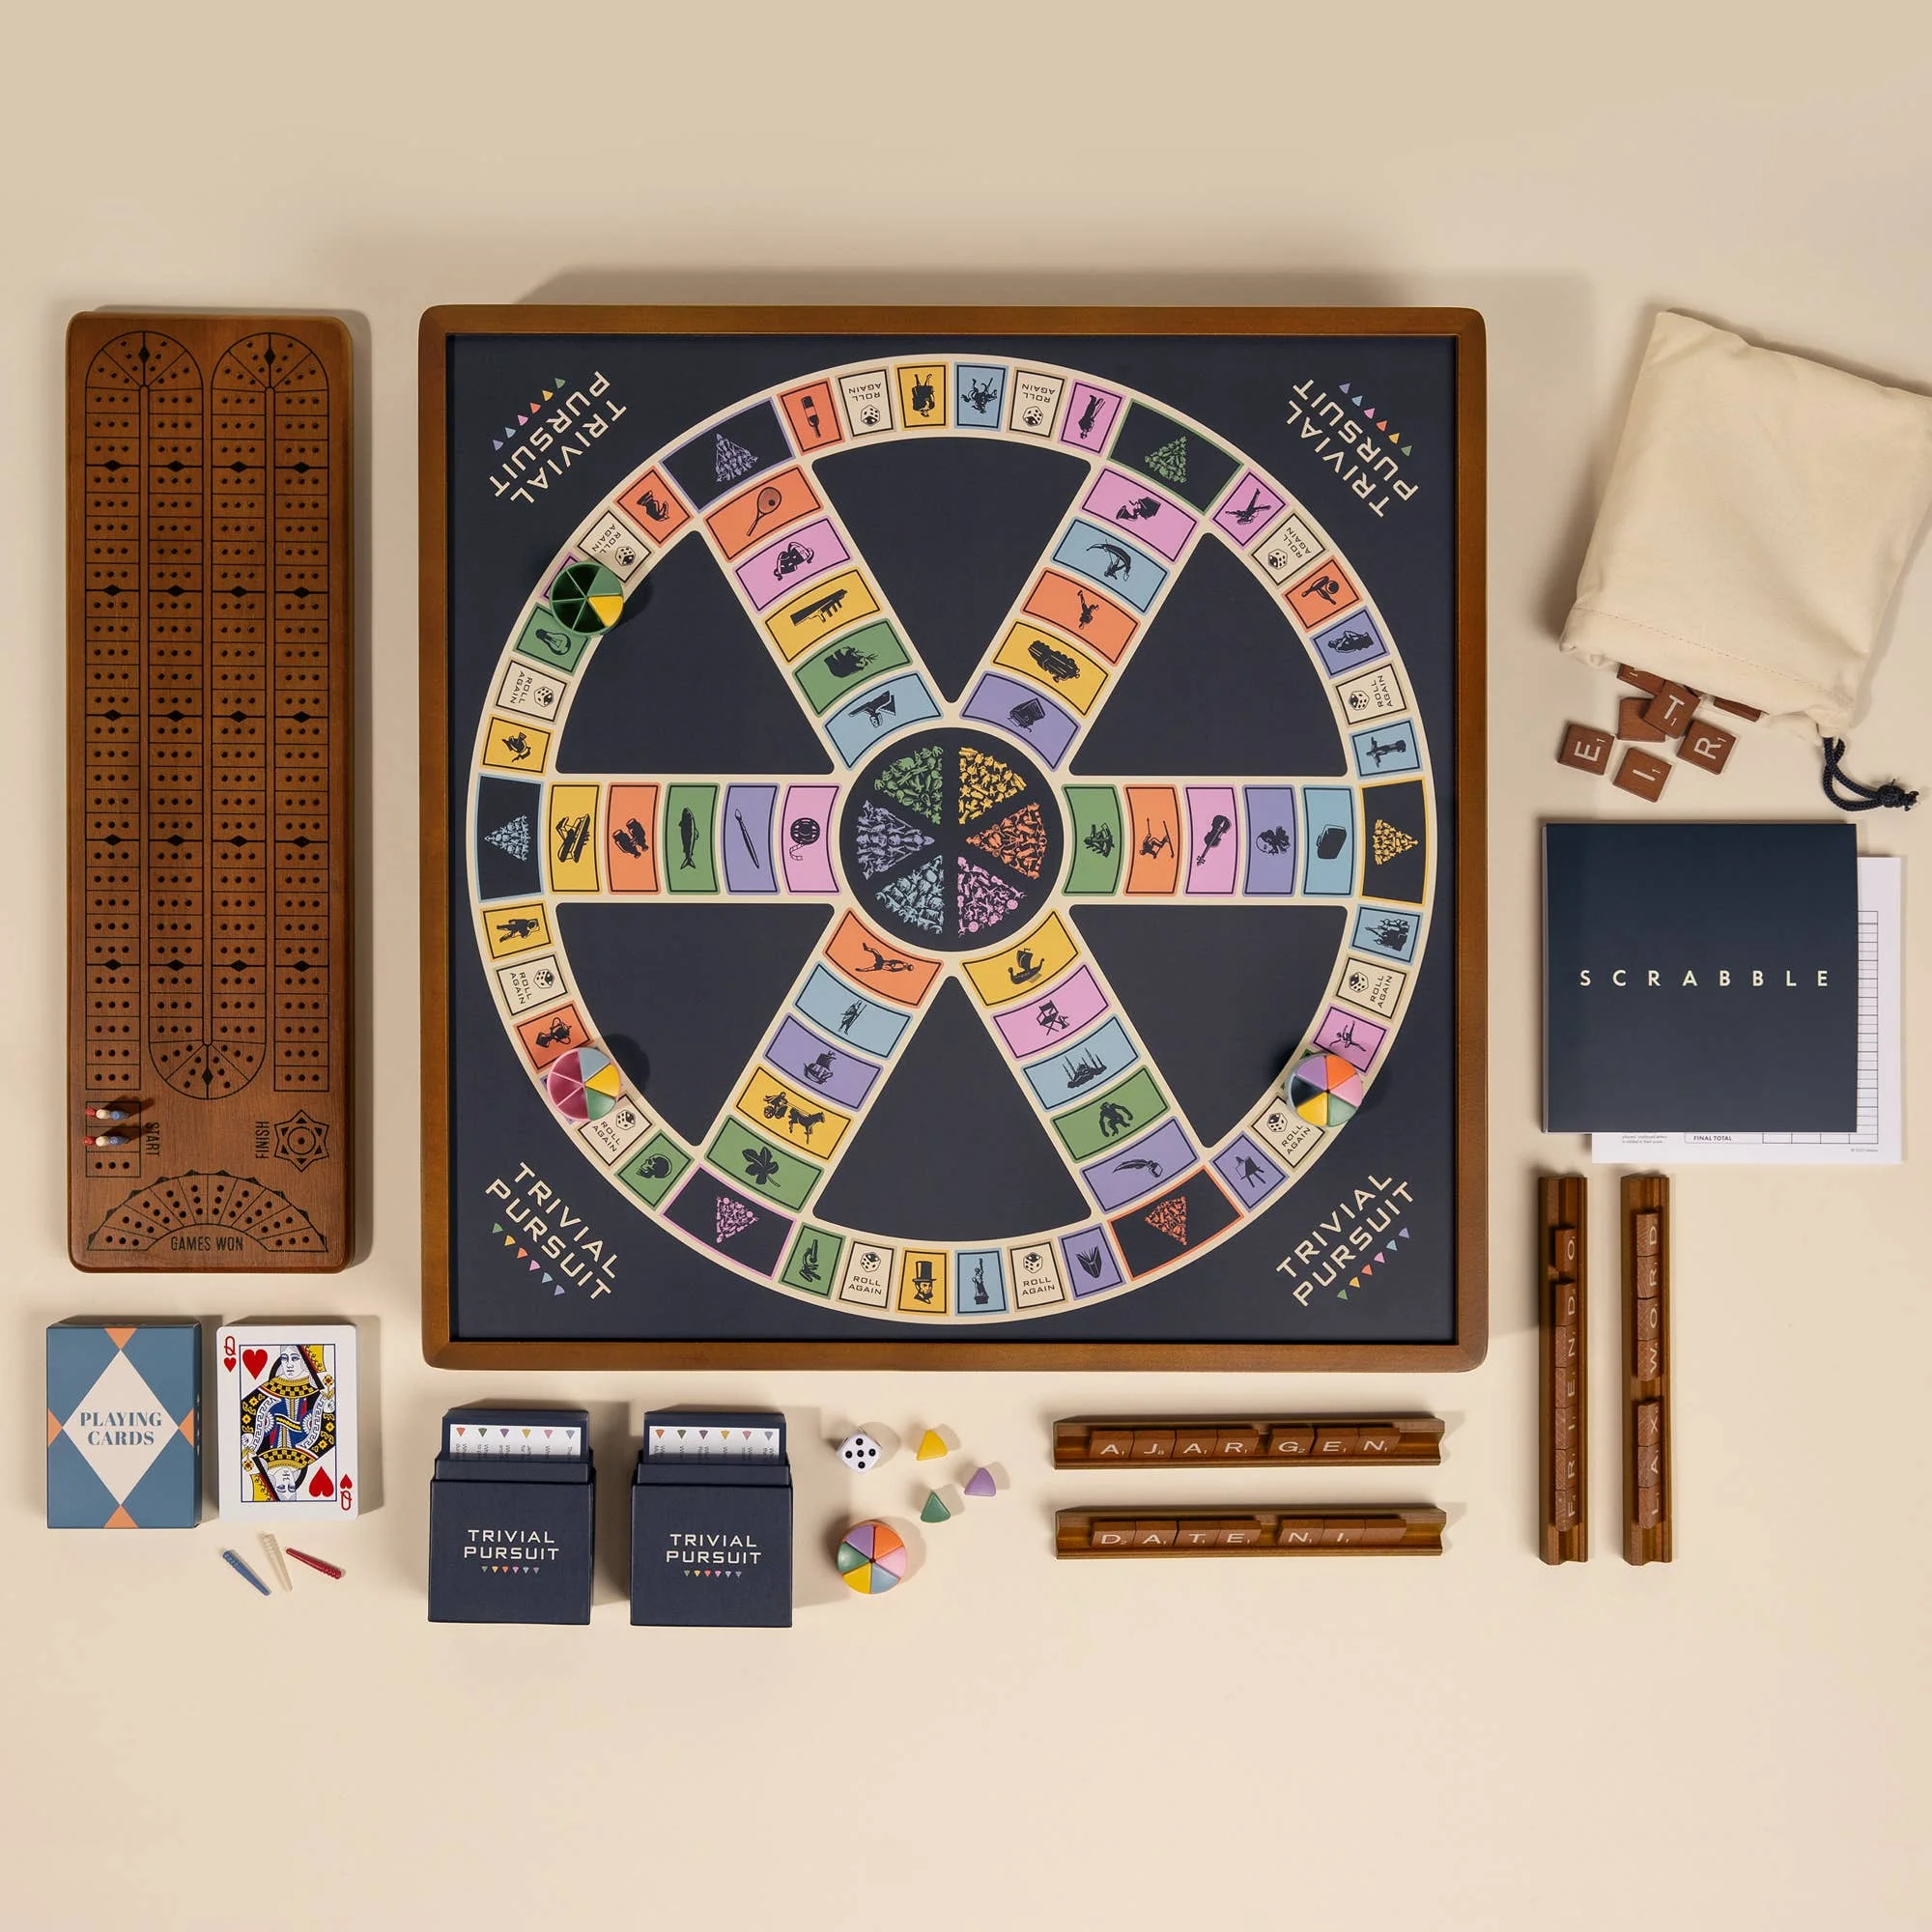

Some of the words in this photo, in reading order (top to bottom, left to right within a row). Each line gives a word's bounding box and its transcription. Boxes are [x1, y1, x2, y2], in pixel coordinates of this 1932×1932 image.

[848, 383, 882, 394] AGAIN
[852, 391, 881, 402] ROLL
[1021, 384, 1056, 396] AGAIN
[1022, 392, 1051, 403] ROLL
[489, 371, 611, 497] PURSUIT
[1293, 379, 1419, 500] PURSUIT
[510, 400, 627, 503] TRIVIAL
[1286, 400, 1390, 517] TRIVIAL
[592, 524, 616, 553] AGAIN
[599, 531, 621, 554] ROLL
[1283, 533, 1303, 558] ROLL
[1287, 526, 1312, 554] AGAIN
[510, 670, 526, 704] AGAIN
[518, 677, 532, 703] ROLL
[1370, 680, 1384, 708] ROLL
[1378, 675, 1393, 707] AGAIN
[1663, 695, 1685, 720] T
[1574, 740, 1601, 762] E
[1693, 737, 1721, 760] R
[509, 972, 526, 1005] AGAIN
[520, 972, 532, 1000] ROLL
[1370, 975, 1384, 1003] ROLL
[1579, 969, 1828, 987] SCRABBLE
[1378, 975, 1393, 1009] AGAIN
[145, 1122, 160, 1157] START
[255, 1121, 270, 1159] FINISH
[591, 1124, 617, 1152] AGAIN
[601, 1121, 621, 1146] ROLL
[1281, 1124, 1303, 1148] ROLL
[1287, 1126, 1311, 1155] AGAIN
[514, 1161, 618, 1279] TRIVIAL
[1275, 1175, 1392, 1278] TRIVIAL
[170, 1236, 212, 1252] GAMES
[215, 1236, 243, 1252] WON
[485, 1179, 611, 1299] PURSUIT
[1293, 1180, 1413, 1307] PURSUIT
[848, 1284, 882, 1295] AGAIN
[853, 1275, 881, 1287] ROLL
[1021, 1284, 1056, 1296] AGAIN
[1023, 1276, 1052, 1288] ROLL
[223, 1335, 237, 1356] Q
[80, 1411, 162, 1427] PLAYING
[87, 1431, 155, 1446] CARDS
[340, 1490, 353, 1511] Q
[468, 1529, 555, 1544] TRIVIAL
[669, 1533, 757, 1548] TRIVIAL
[464, 1547, 559, 1561] PURSUIT
[667, 1550, 761, 1565] PURSUIT
